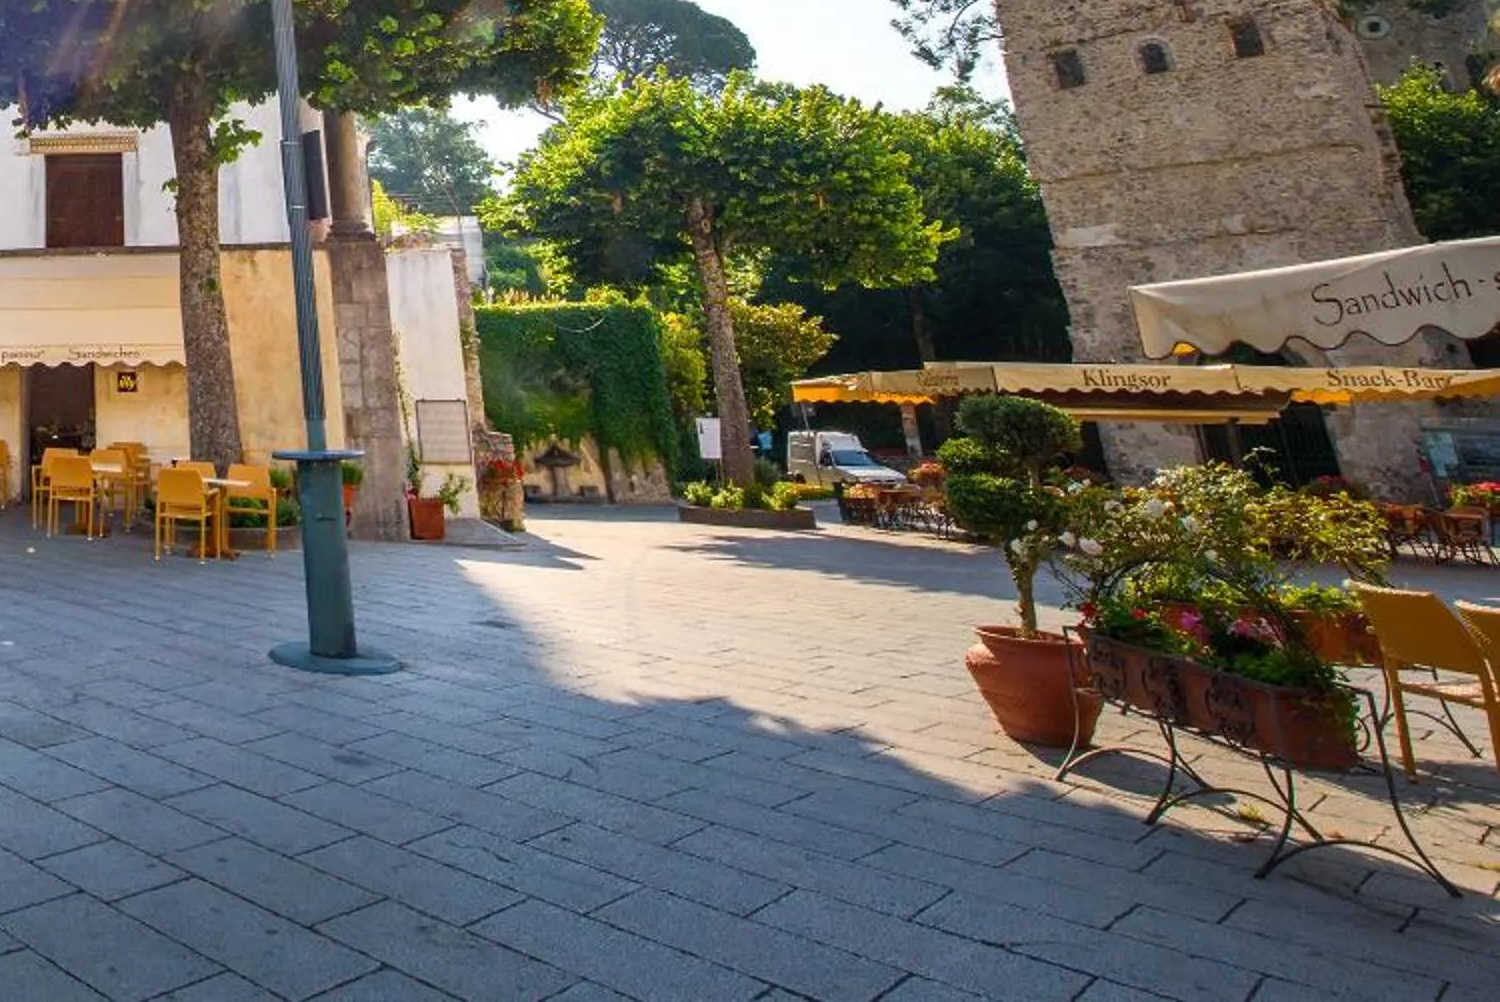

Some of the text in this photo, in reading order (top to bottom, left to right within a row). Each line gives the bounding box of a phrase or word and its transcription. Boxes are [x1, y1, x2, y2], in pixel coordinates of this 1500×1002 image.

[1311, 262, 1472, 327] Sandwich
[1082, 368, 1172, 390] Klingsor
[1326, 369, 1449, 390] Snack-Bar
